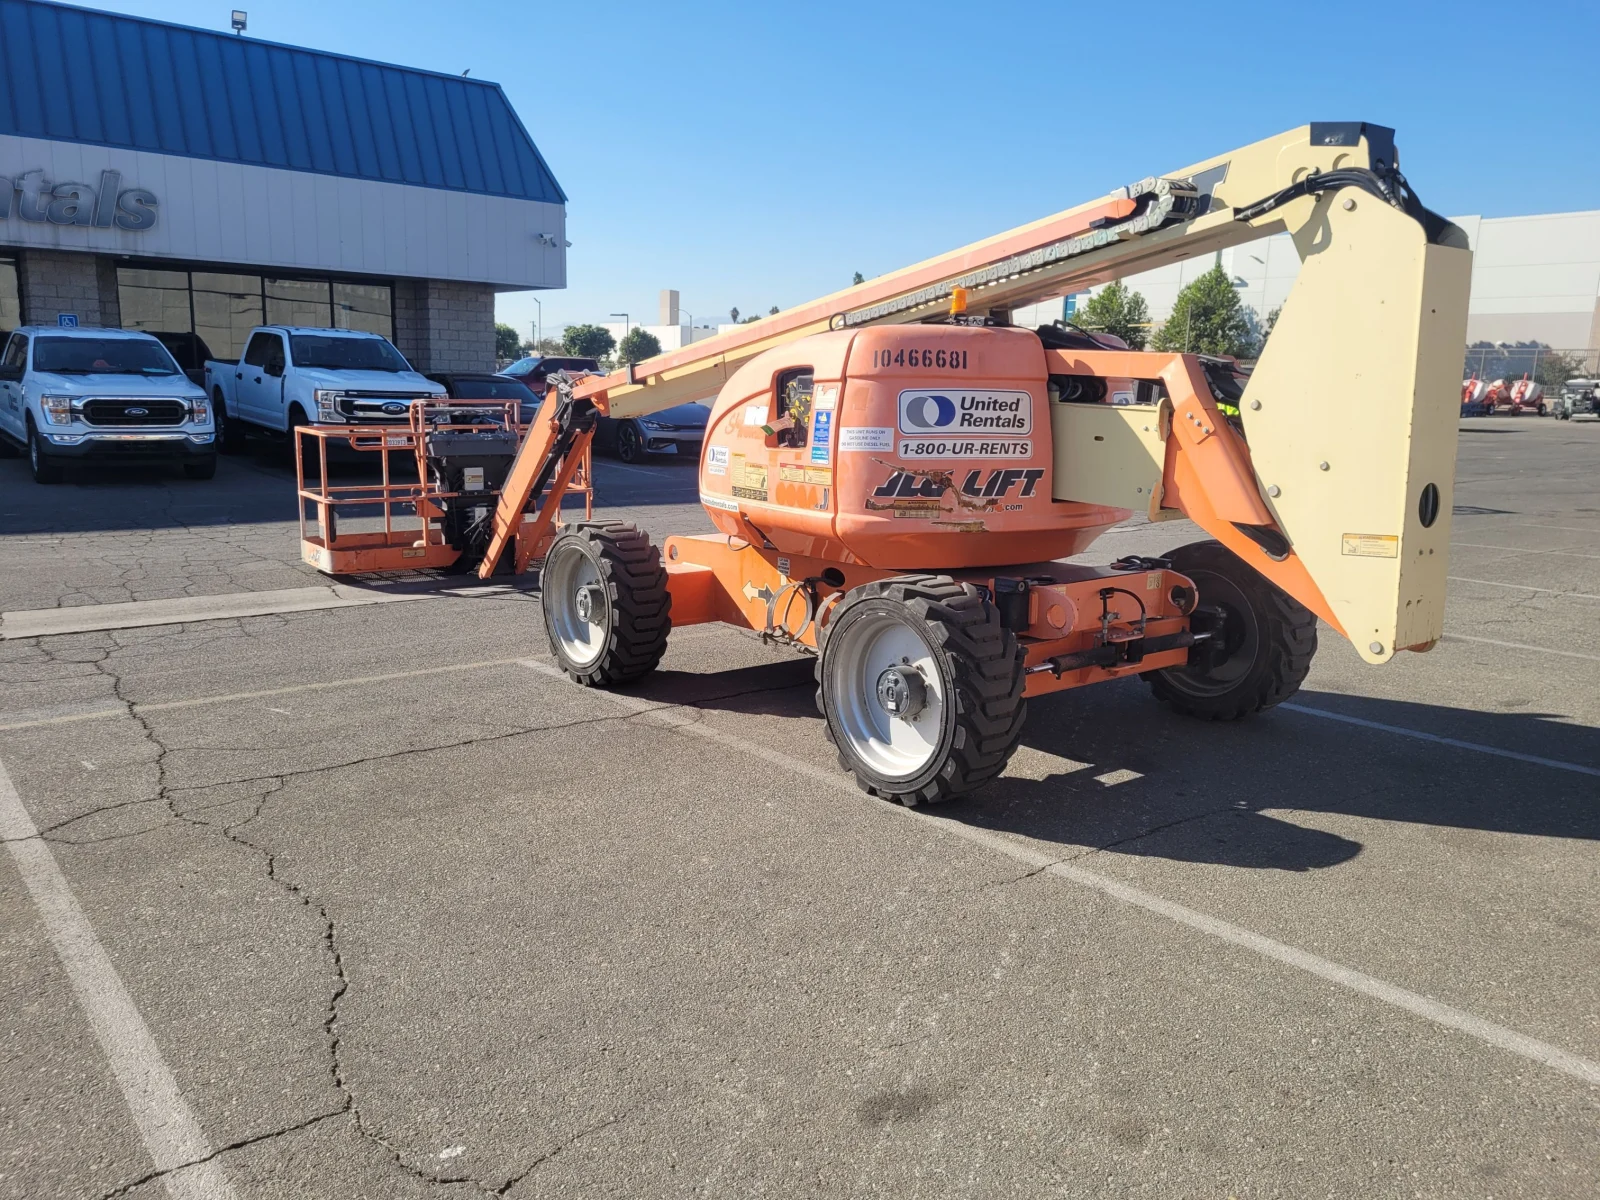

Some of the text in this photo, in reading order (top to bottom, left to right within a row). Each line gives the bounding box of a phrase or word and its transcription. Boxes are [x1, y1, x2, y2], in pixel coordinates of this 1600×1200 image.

[873, 349, 967, 369] 10466681
[960, 396, 1020, 412] United
[959, 413, 1025, 429] Rentals
[902, 443, 1029, 455] 1-800-UR-RENTS
[960, 468, 1045, 498] LIFT
